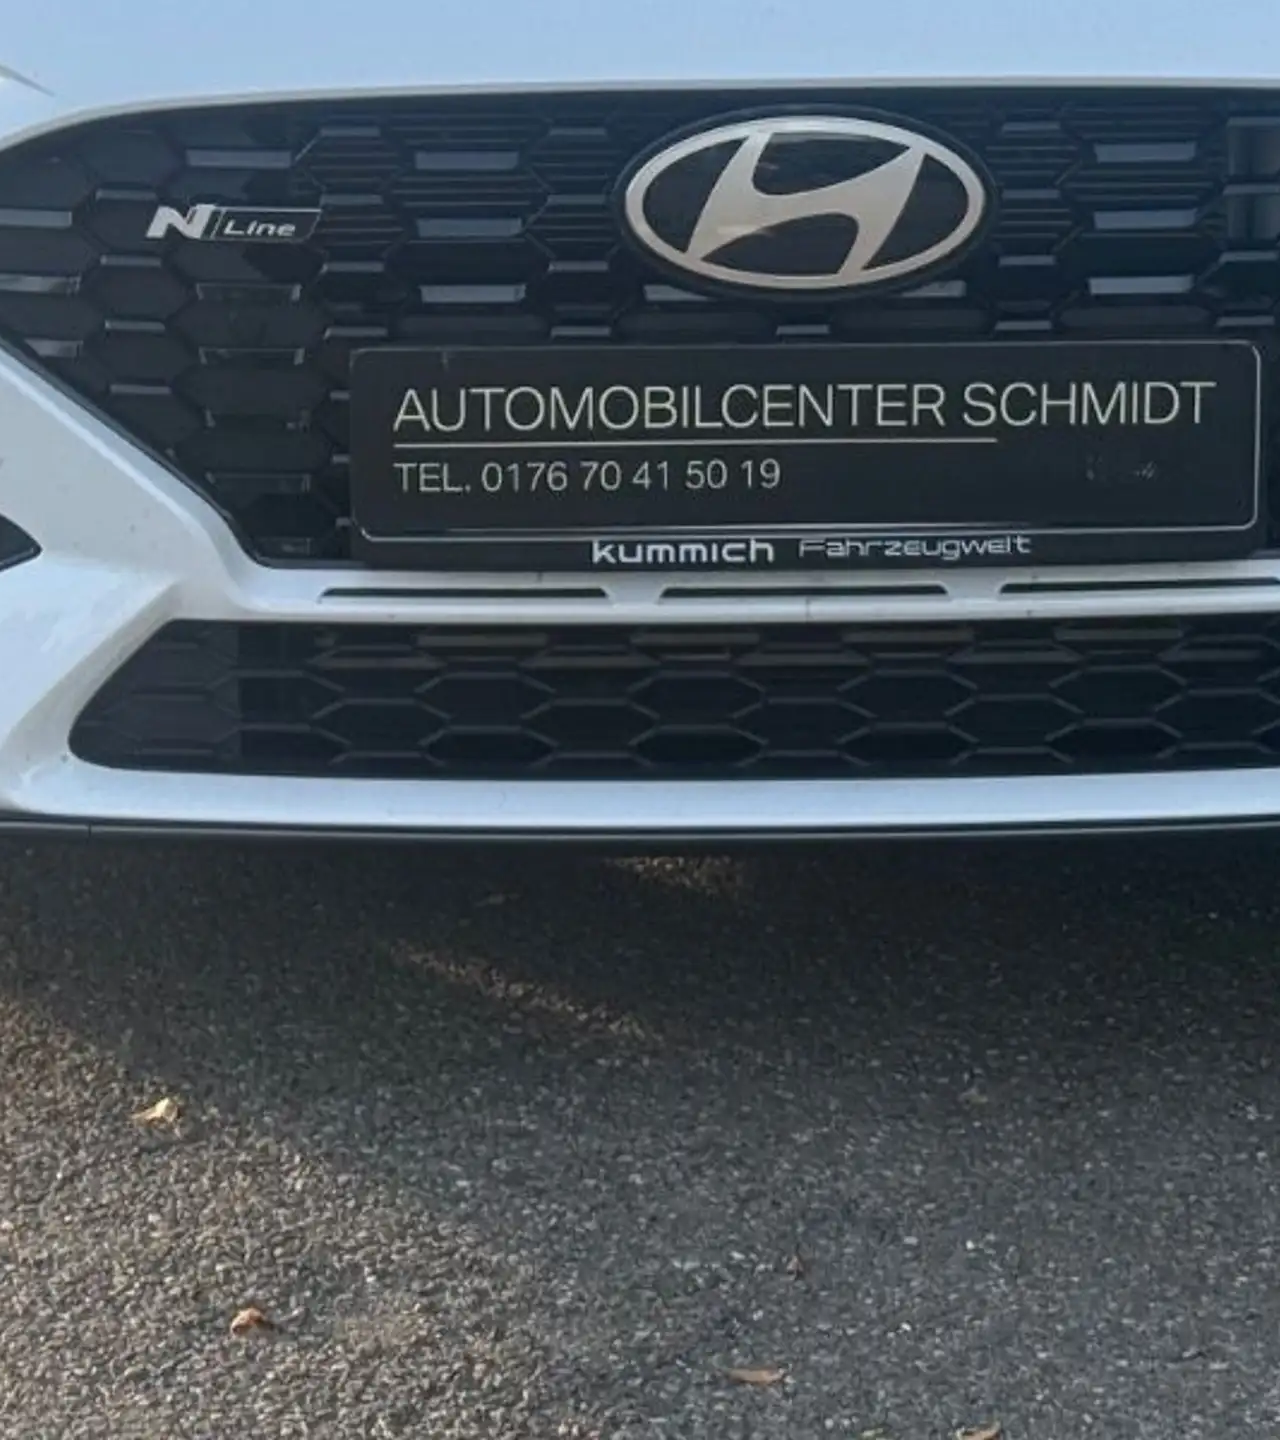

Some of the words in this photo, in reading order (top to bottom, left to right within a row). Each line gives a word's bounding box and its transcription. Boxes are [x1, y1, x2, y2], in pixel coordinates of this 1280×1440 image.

[393, 382, 946, 433] AUTOMOBILCENTER
[962, 380, 1217, 428] SCHMIDT
[394, 462, 472, 493] TEL.
[481, 462, 569, 493] 0176
[579, 461, 622, 492] 70
[631, 461, 670, 491] 41
[684, 459, 729, 491] 50
[740, 458, 781, 489] 19
[798, 534, 1032, 561] Fahrzeugwelt
